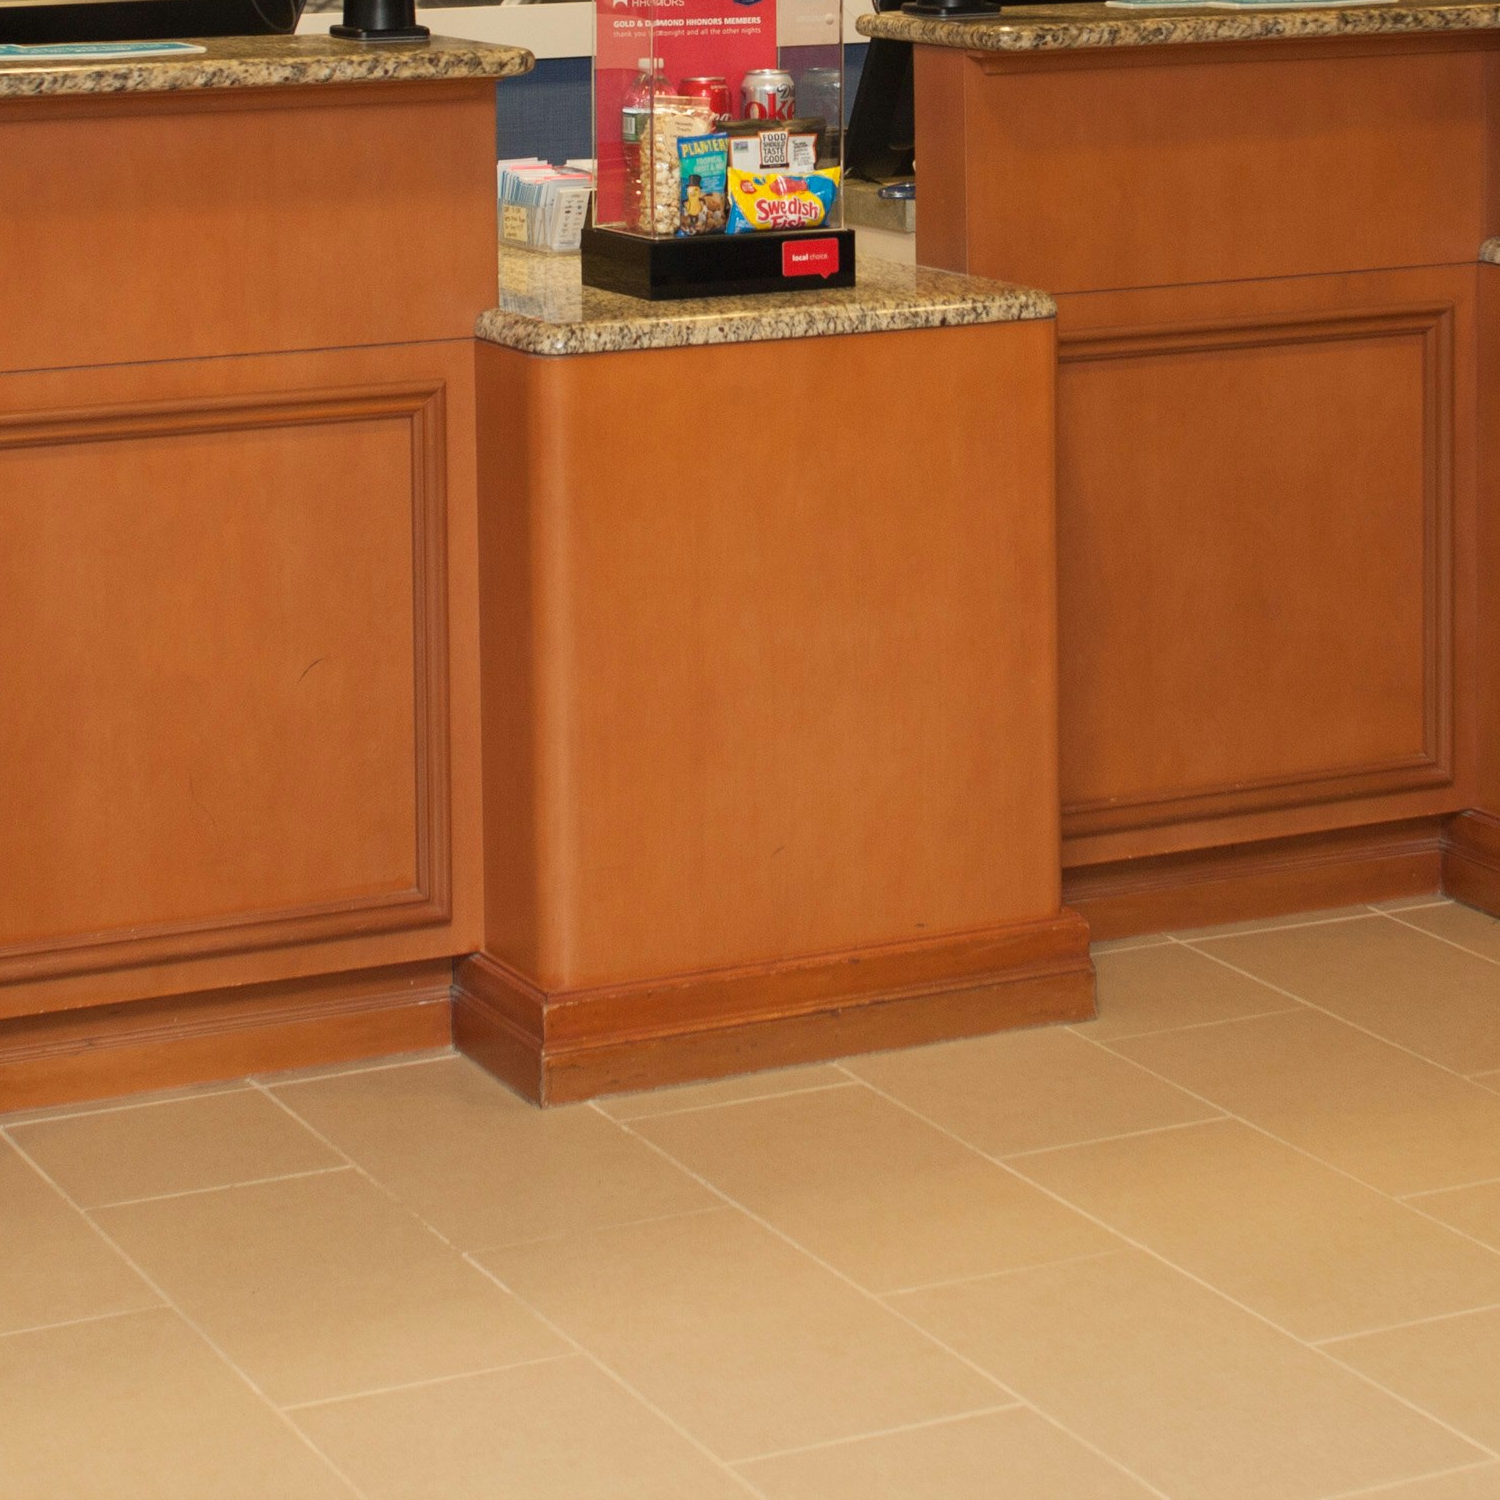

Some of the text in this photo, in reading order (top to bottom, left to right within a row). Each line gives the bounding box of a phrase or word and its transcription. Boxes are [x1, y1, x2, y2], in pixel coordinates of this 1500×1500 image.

[613, 20, 635, 28] GOLD
[645, 19, 685, 28] DAMOND
[686, 18, 723, 26] HHONORS
[724, 17, 761, 25] MEMBERS
[613, 30, 632, 38] thank
[634, 31, 647, 39] you
[722, 27, 739, 35] other
[741, 27, 761, 36] nights
[744, 93, 796, 120] oke
[762, 133, 787, 141] FOOD
[763, 147, 784, 155] TASTE
[763, 155, 785, 163] GOOD
[755, 197, 819, 222] Swedish
[792, 254, 809, 262] local
